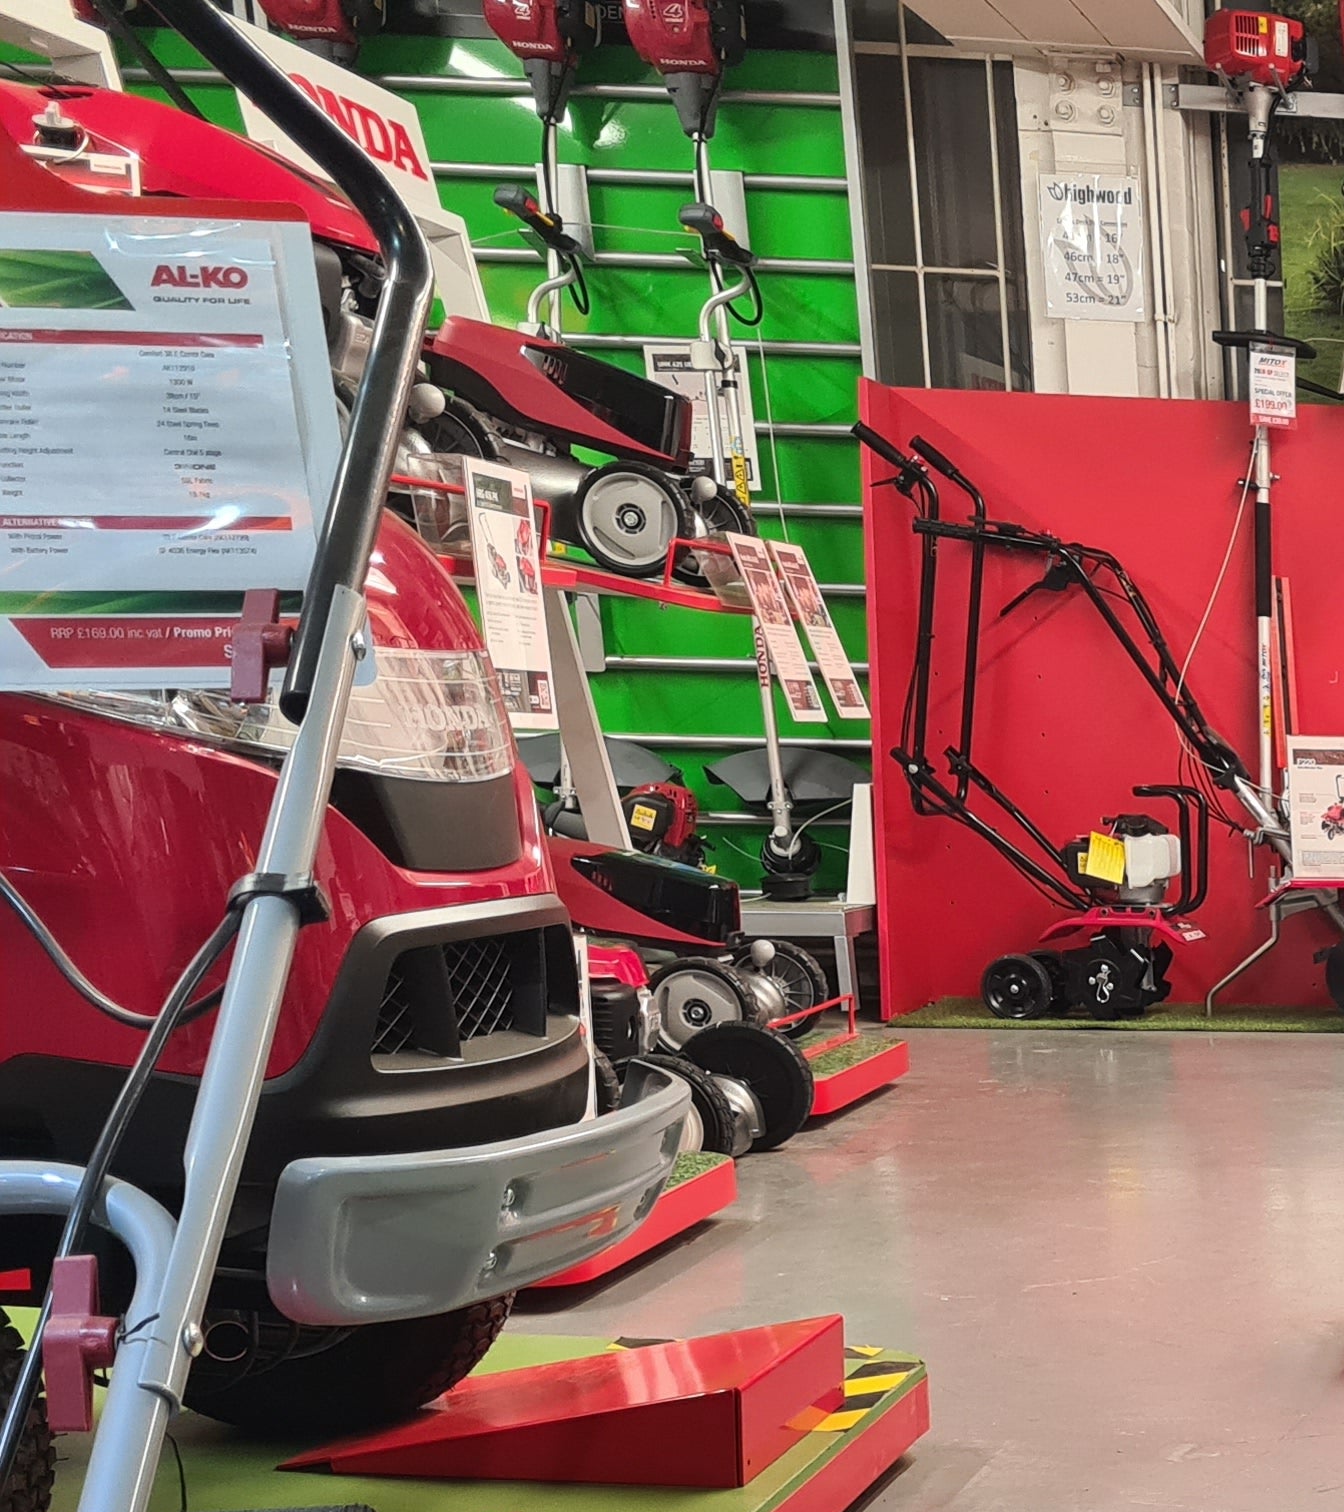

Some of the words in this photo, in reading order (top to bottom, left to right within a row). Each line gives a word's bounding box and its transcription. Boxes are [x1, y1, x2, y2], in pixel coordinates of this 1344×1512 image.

[512, 41, 554, 51] HONDA
[660, 58, 706, 67] HONDA
[1064, 251, 1093, 262] 46cm
[1107, 253, 1124, 264] 18"
[150, 264, 249, 290] AL-KO
[1065, 272, 1094, 283] 47cm
[1107, 274, 1125, 284] 19"
[153, 295, 201, 304] QUALITY
[1066, 292, 1096, 304] 53cm
[1108, 295, 1126, 305] 21"
[51, 627, 74, 639] RRP
[77, 627, 125, 639] £169.00
[128, 628, 142, 638] inc
[145, 628, 163, 639] vat
[173, 627, 212, 639] Promo
[214, 627, 234, 639] Pri
[754, 624, 770, 689] HONDA
